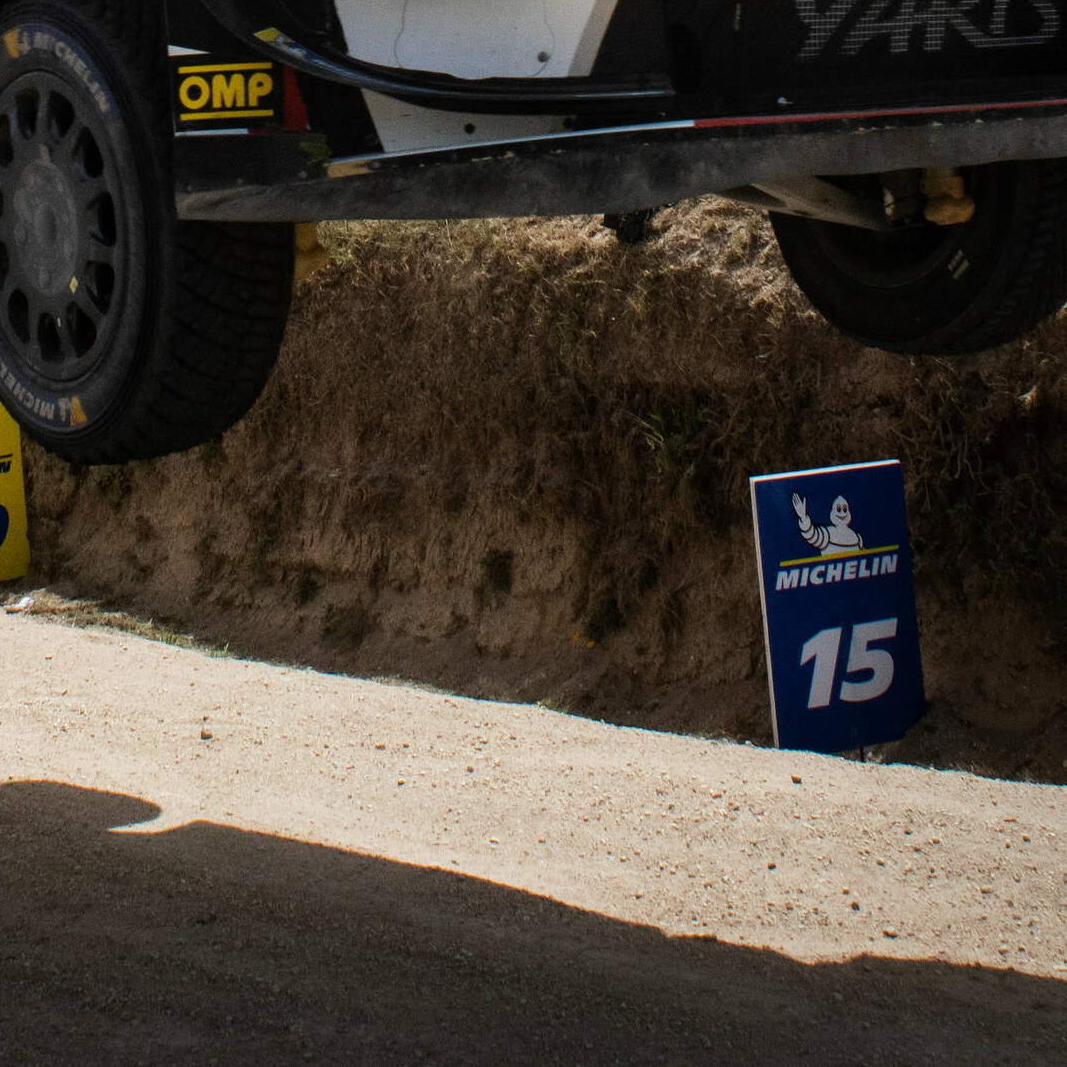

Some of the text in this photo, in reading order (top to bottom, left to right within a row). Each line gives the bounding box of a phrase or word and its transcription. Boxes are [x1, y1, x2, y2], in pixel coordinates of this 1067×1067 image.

[178, 72, 273, 110] OMP
[775, 554, 899, 591] MICHELIN
[799, 617, 898, 709] 15
